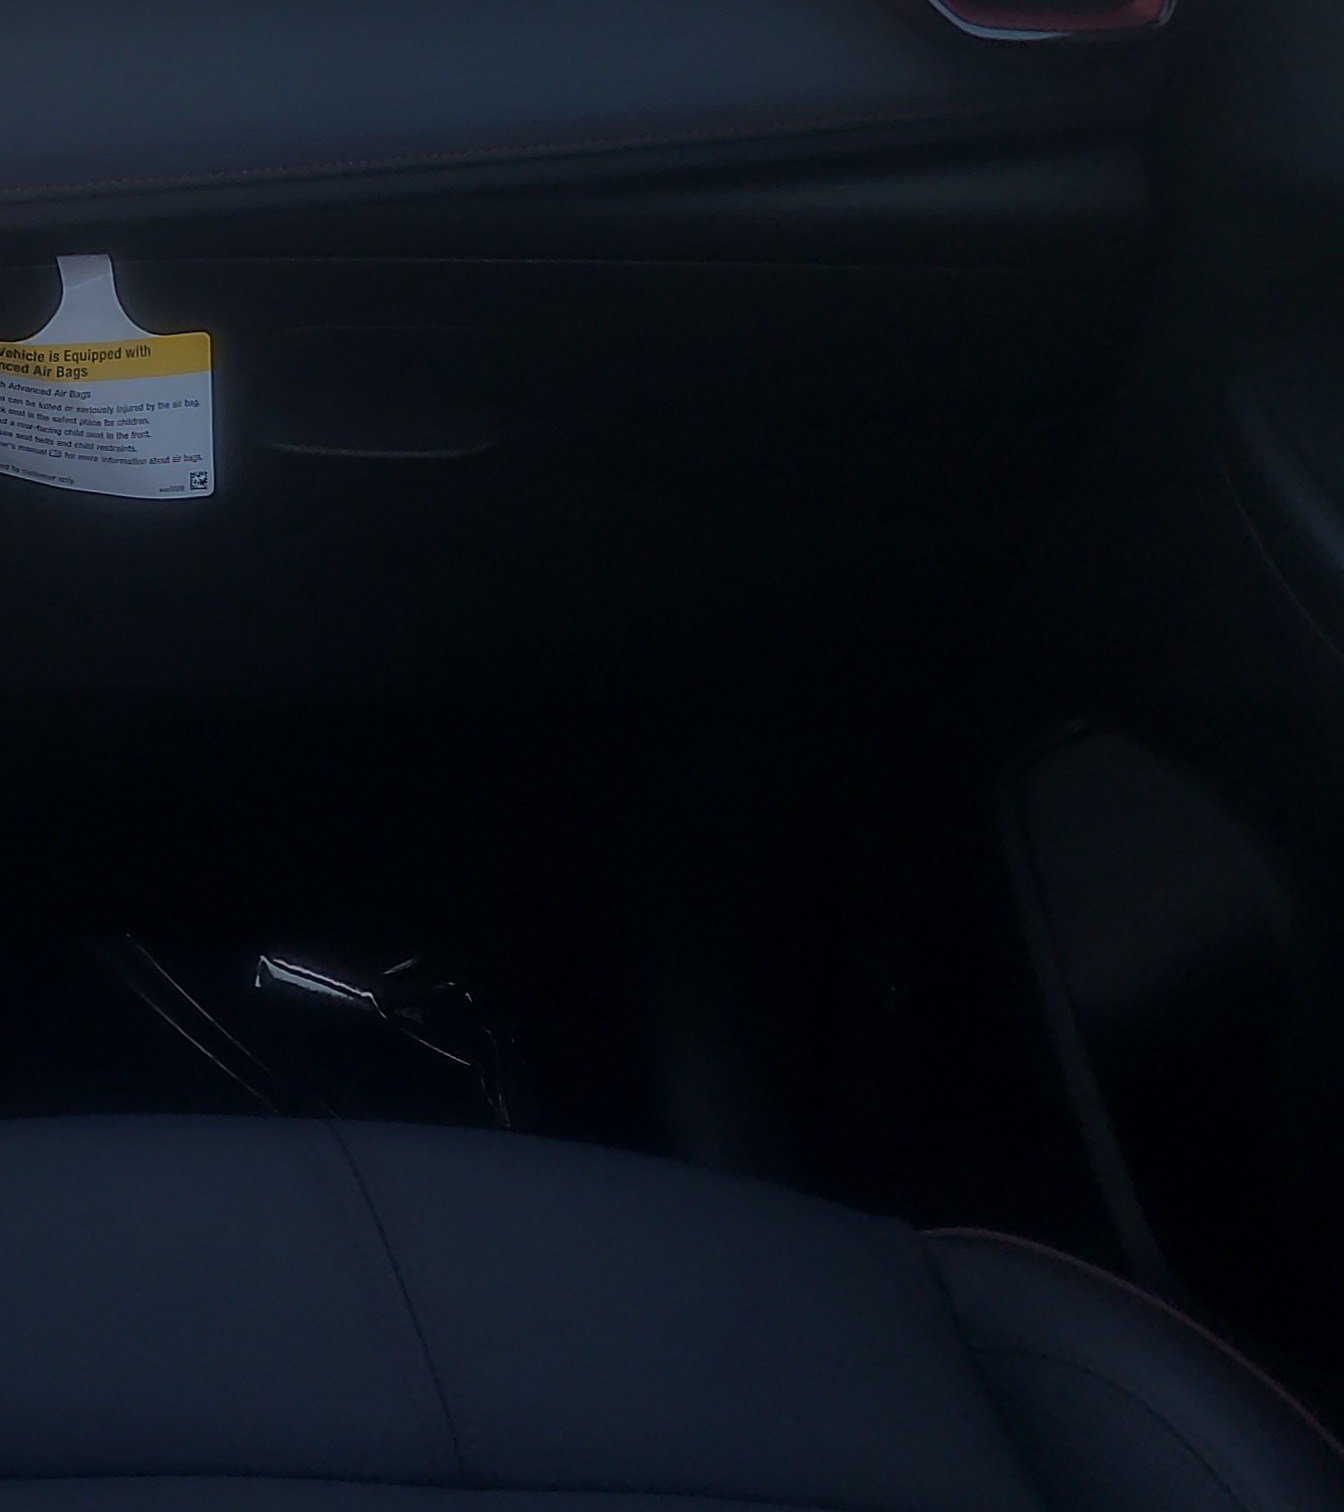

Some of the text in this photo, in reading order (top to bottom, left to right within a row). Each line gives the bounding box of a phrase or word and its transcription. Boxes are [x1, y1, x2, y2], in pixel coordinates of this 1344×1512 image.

[49, 350, 59, 362] is
[64, 347, 121, 364] Equipped
[125, 345, 151, 358] with
[33, 365, 52, 377] Air
[56, 366, 88, 379] Bags
[8, 382, 51, 396] Advanced
[53, 389, 67, 398] Air
[69, 390, 91, 401] Bags
